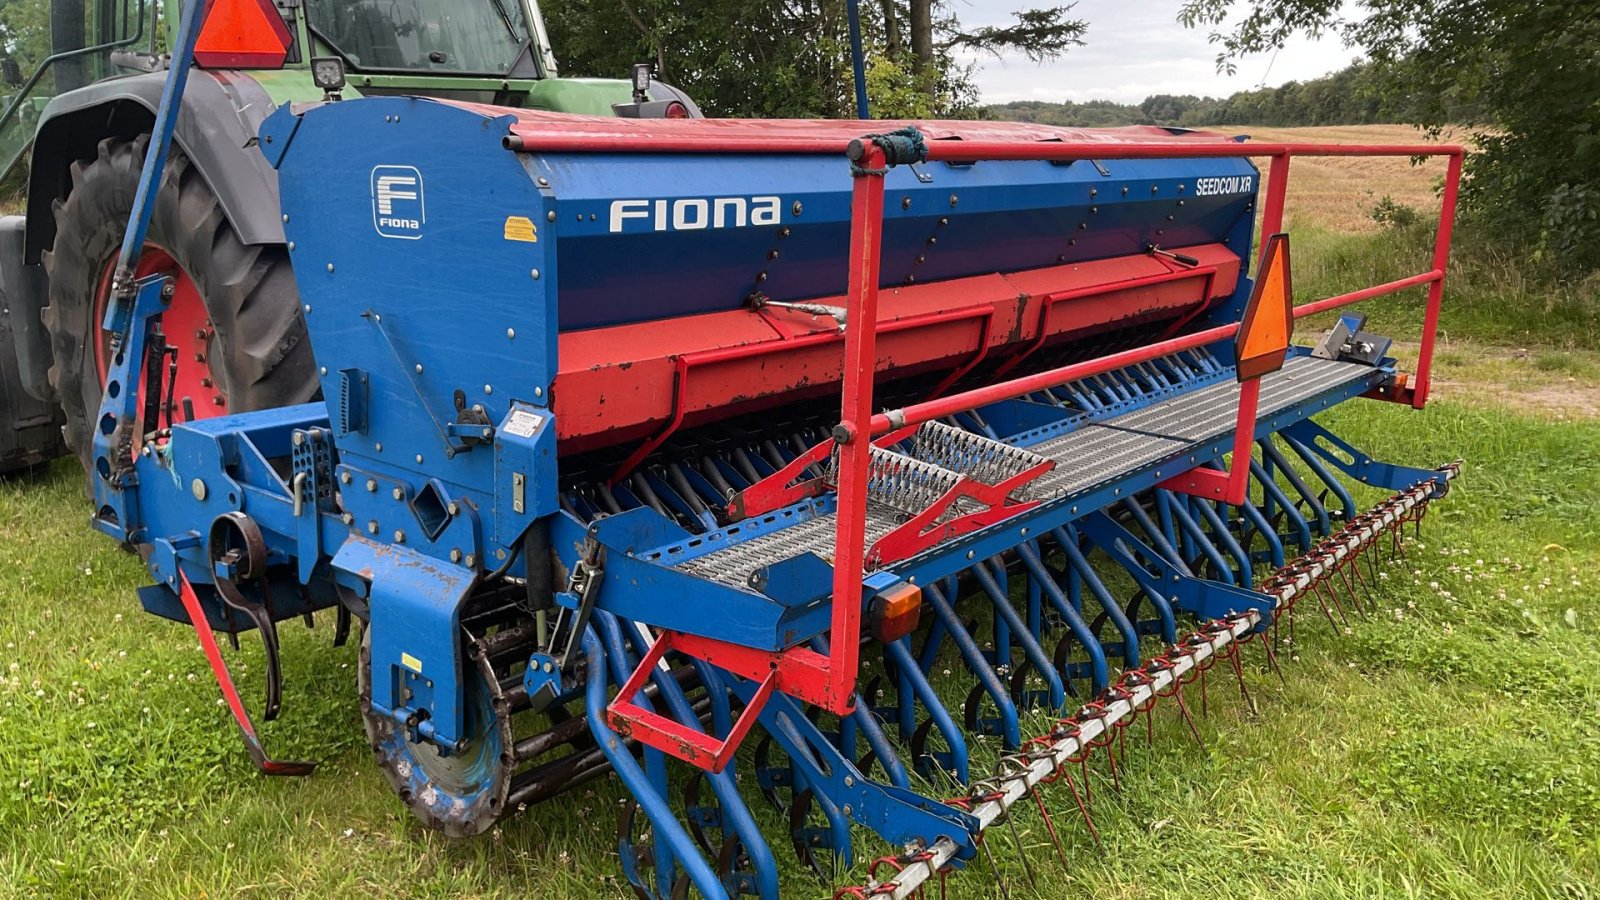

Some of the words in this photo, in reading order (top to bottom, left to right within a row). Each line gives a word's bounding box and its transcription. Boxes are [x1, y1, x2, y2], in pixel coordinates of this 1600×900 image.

[377, 176, 417, 215] F
[1196, 177, 1239, 196] SEEDCOM
[1239, 176, 1252, 193] XR
